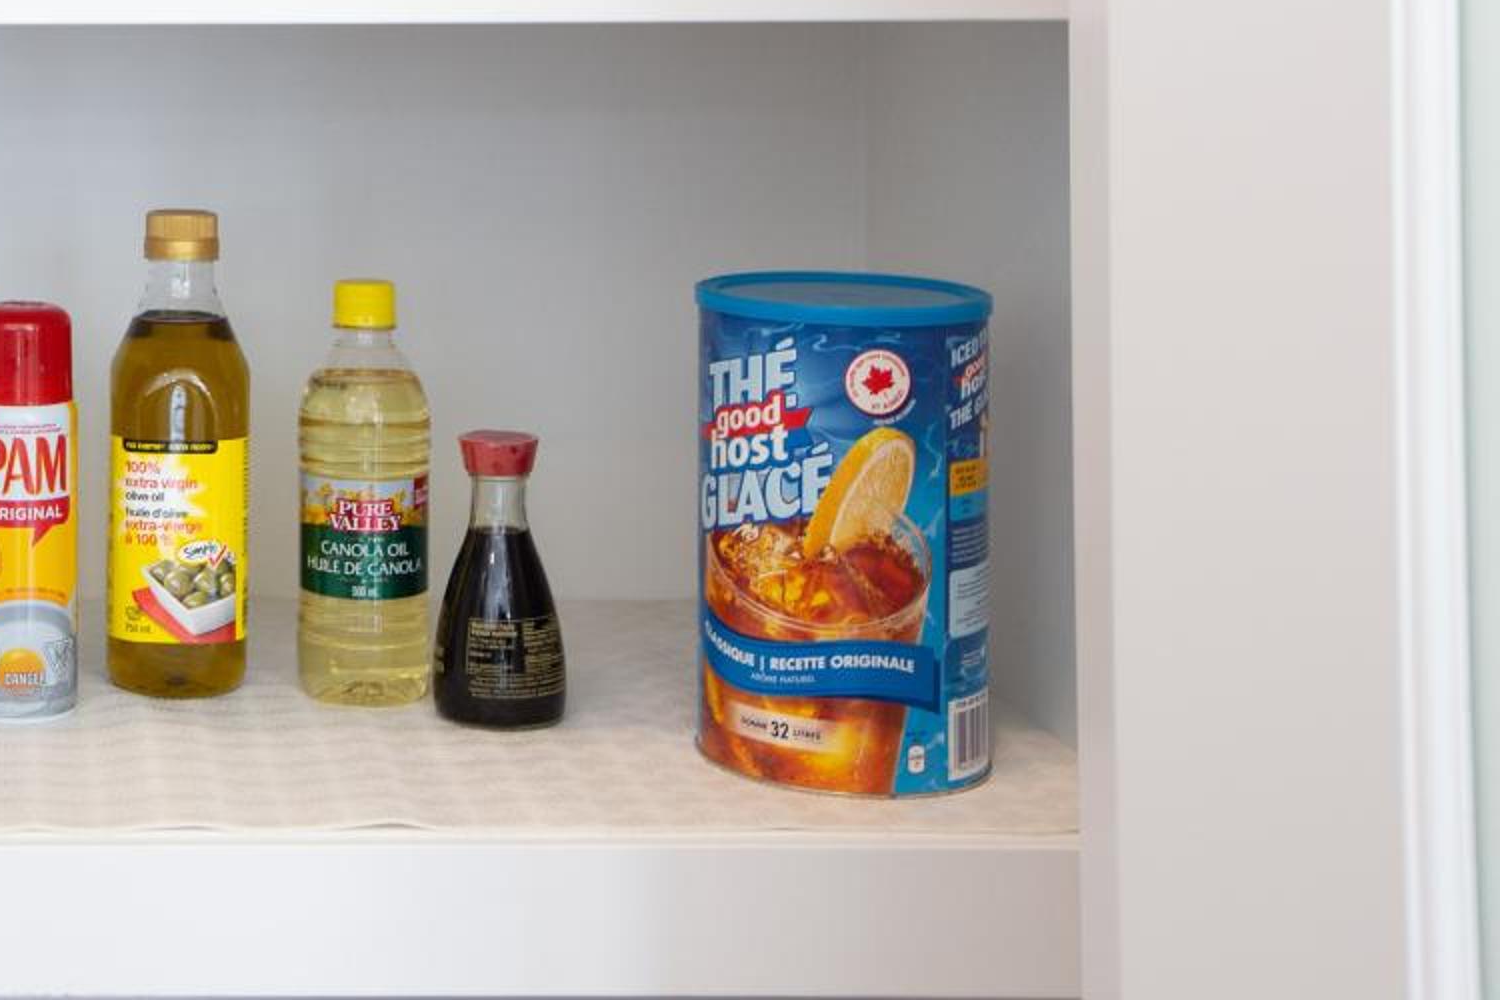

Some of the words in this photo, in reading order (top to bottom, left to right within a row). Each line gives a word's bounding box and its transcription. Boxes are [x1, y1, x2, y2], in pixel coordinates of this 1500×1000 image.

[709, 336, 798, 410] THÉ
[716, 394, 782, 440] good
[710, 424, 789, 470] host
[125, 477, 158, 489] extra
[161, 477, 198, 493] virgin
[701, 442, 833, 530] GLACÉ
[125, 491, 149, 501] olive
[151, 491, 165, 501] oil
[125, 507, 150, 518] huile
[339, 499, 393, 517] PURE
[329, 513, 402, 531] VALLEY
[320, 540, 384, 557] CANOLA
[387, 542, 410, 556] OIL
[307, 555, 341, 575] HUILE
[344, 561, 362, 575] DE
[367, 557, 421, 576] CANOLA
[769, 655, 826, 672] RECETTE
[830, 654, 916, 674] ORIGINALE
[769, 719, 791, 740] 32
